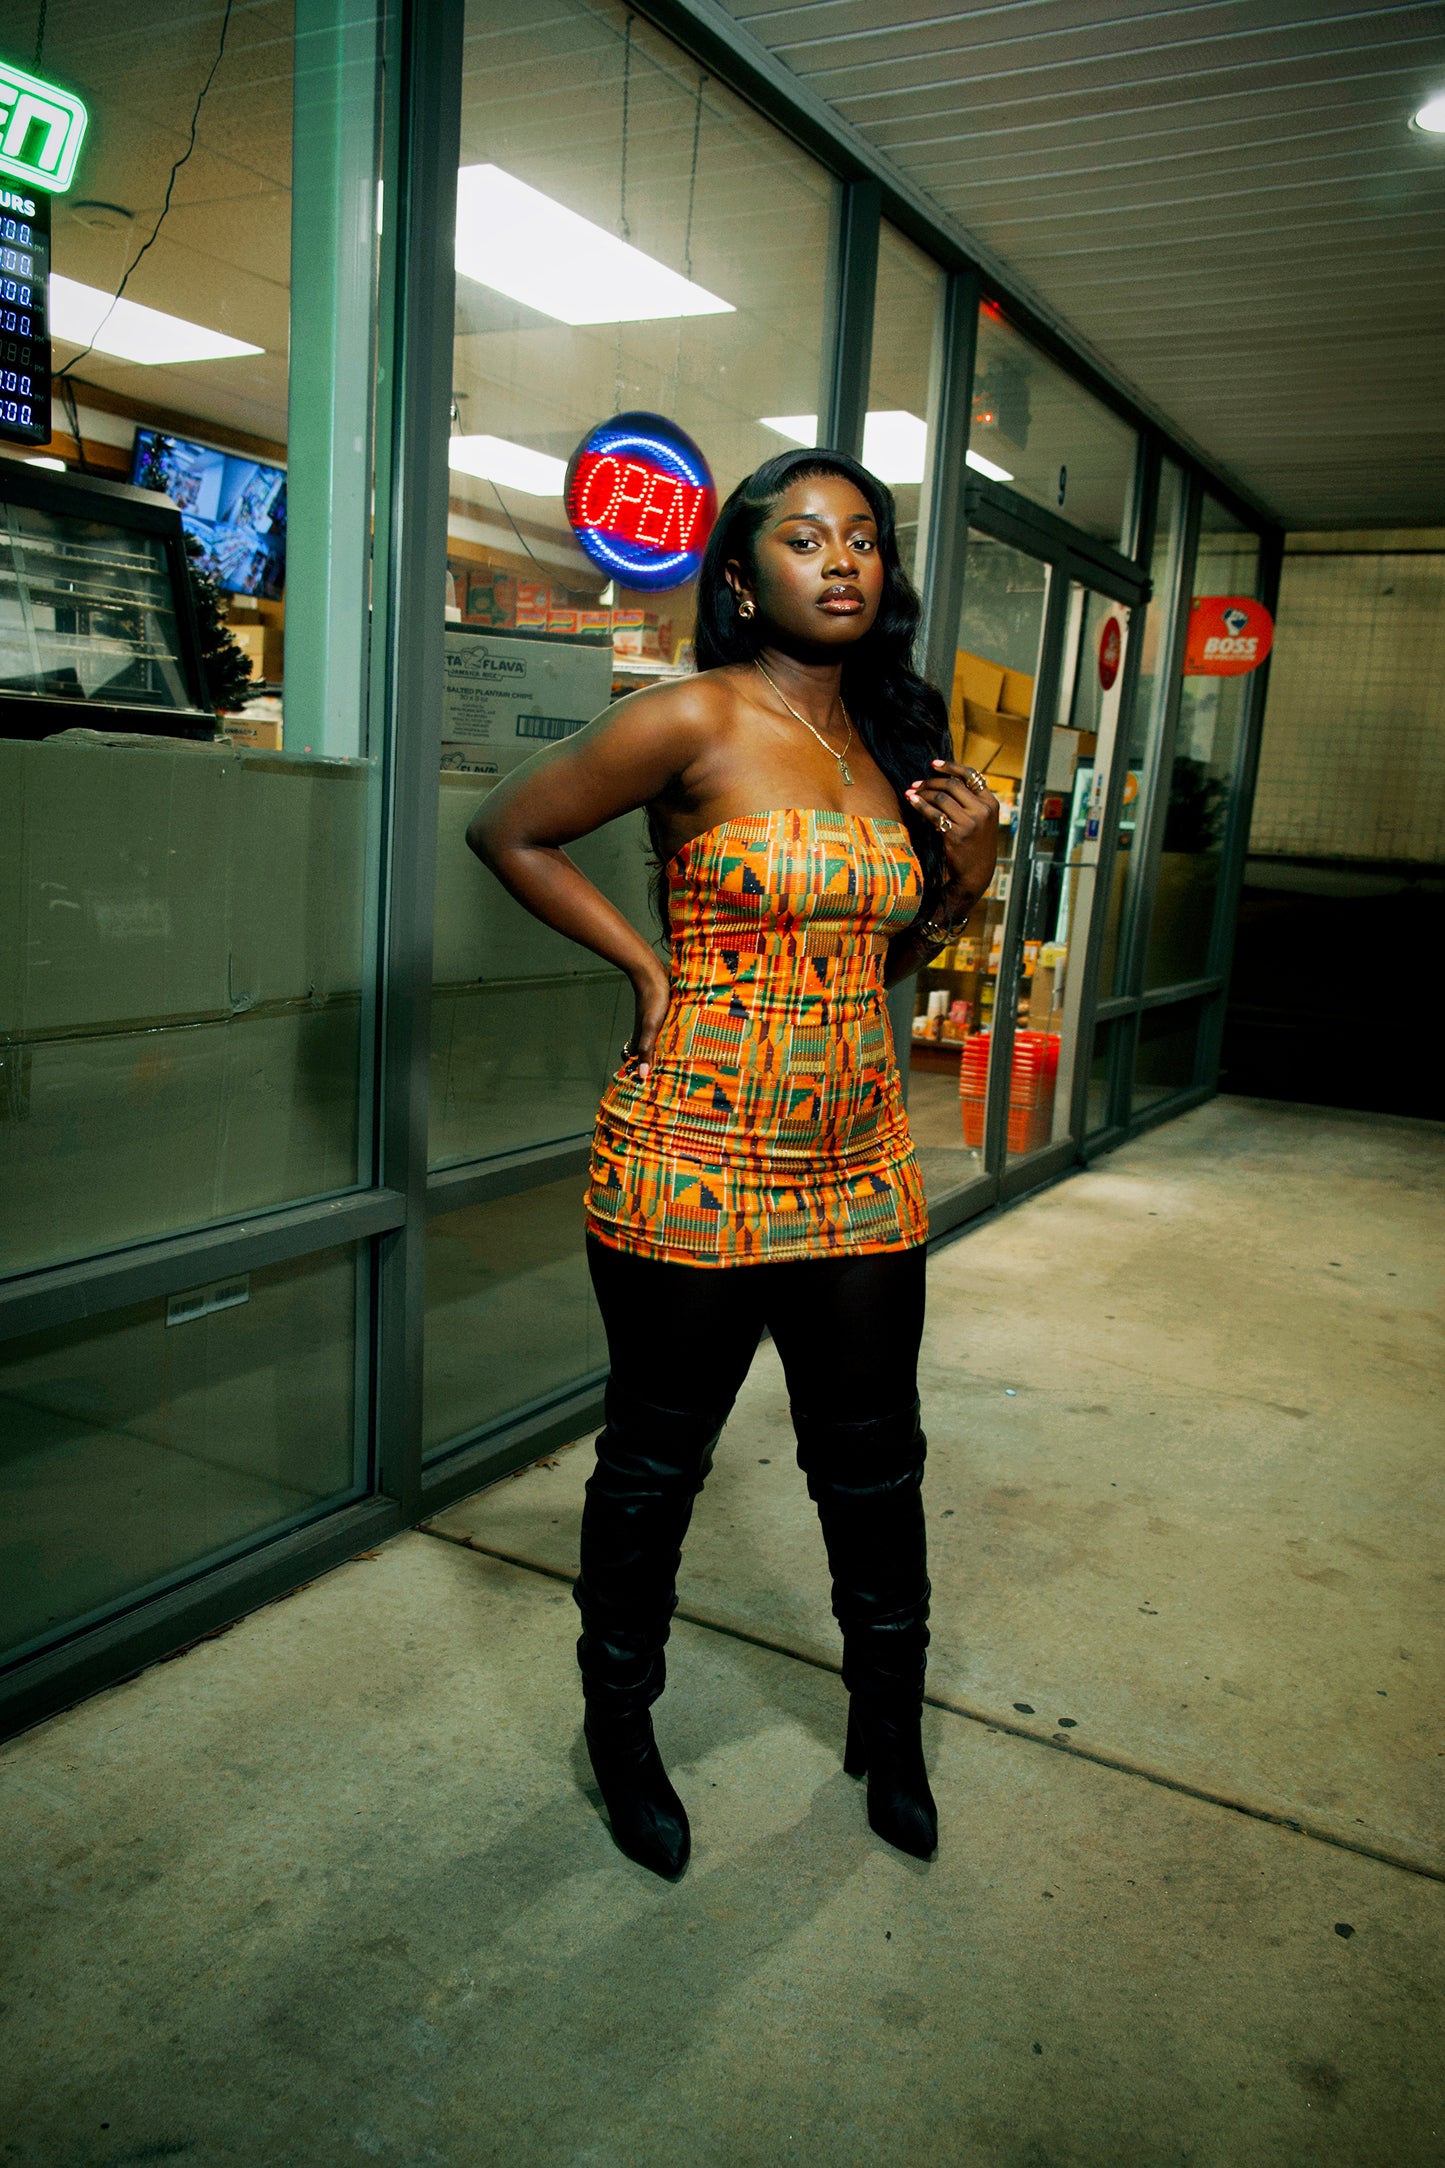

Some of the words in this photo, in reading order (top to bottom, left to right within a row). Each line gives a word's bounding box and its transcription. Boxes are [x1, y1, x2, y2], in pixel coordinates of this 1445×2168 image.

[1058, 465, 1067, 507] 9
[581, 456, 704, 552] OPEN
[1203, 636, 1259, 654] BOSS
[482, 659, 524, 673] FLAVA
[447, 686, 474, 695] SALTED
[475, 689, 511, 698] PLANTAIN
